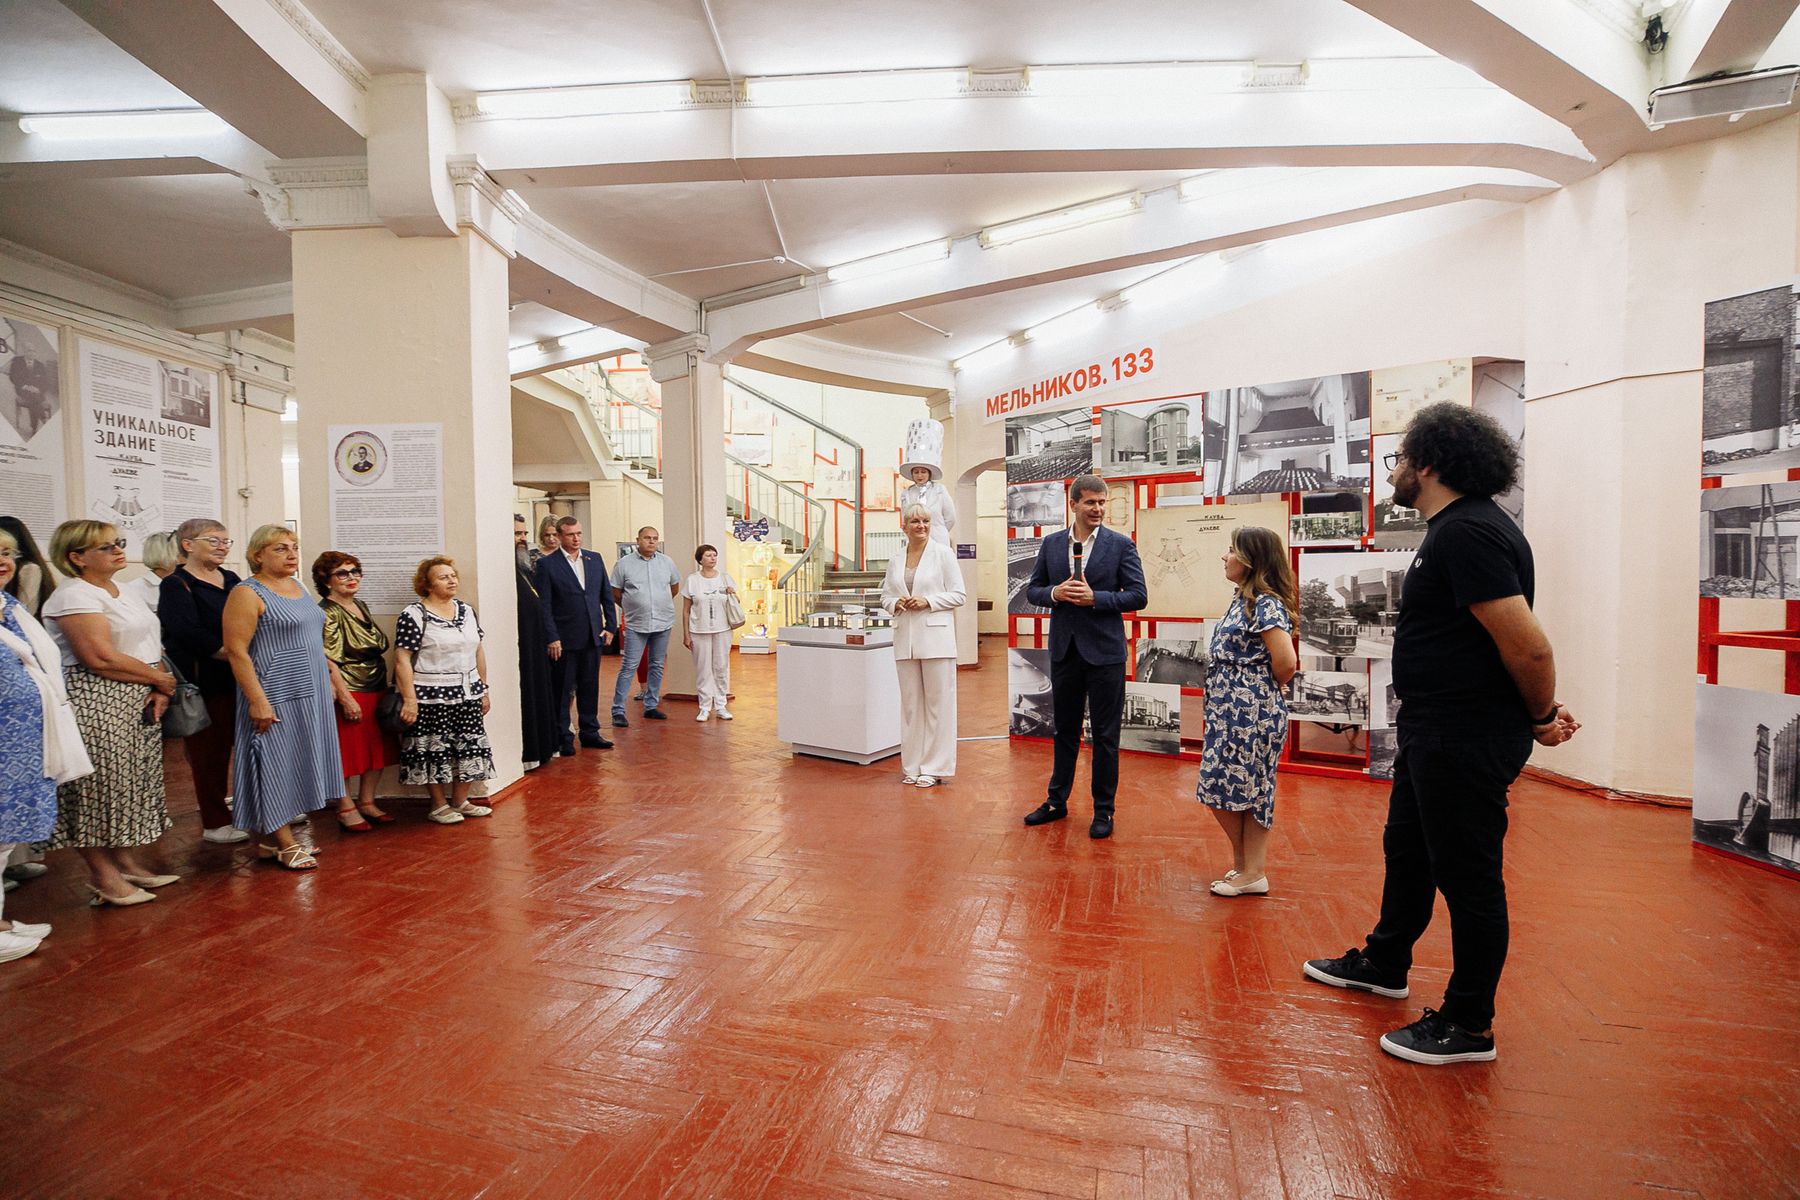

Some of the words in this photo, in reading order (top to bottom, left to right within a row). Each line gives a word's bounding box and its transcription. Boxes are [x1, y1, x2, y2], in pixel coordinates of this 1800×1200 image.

[986, 364, 1107, 417] МЕЛЬНИКОВ.
[1111, 347, 1154, 381] 133
[93, 409, 196, 441] УНИКАЛЬНОЕ
[94, 429, 156, 452] ЗДАНИЕ
